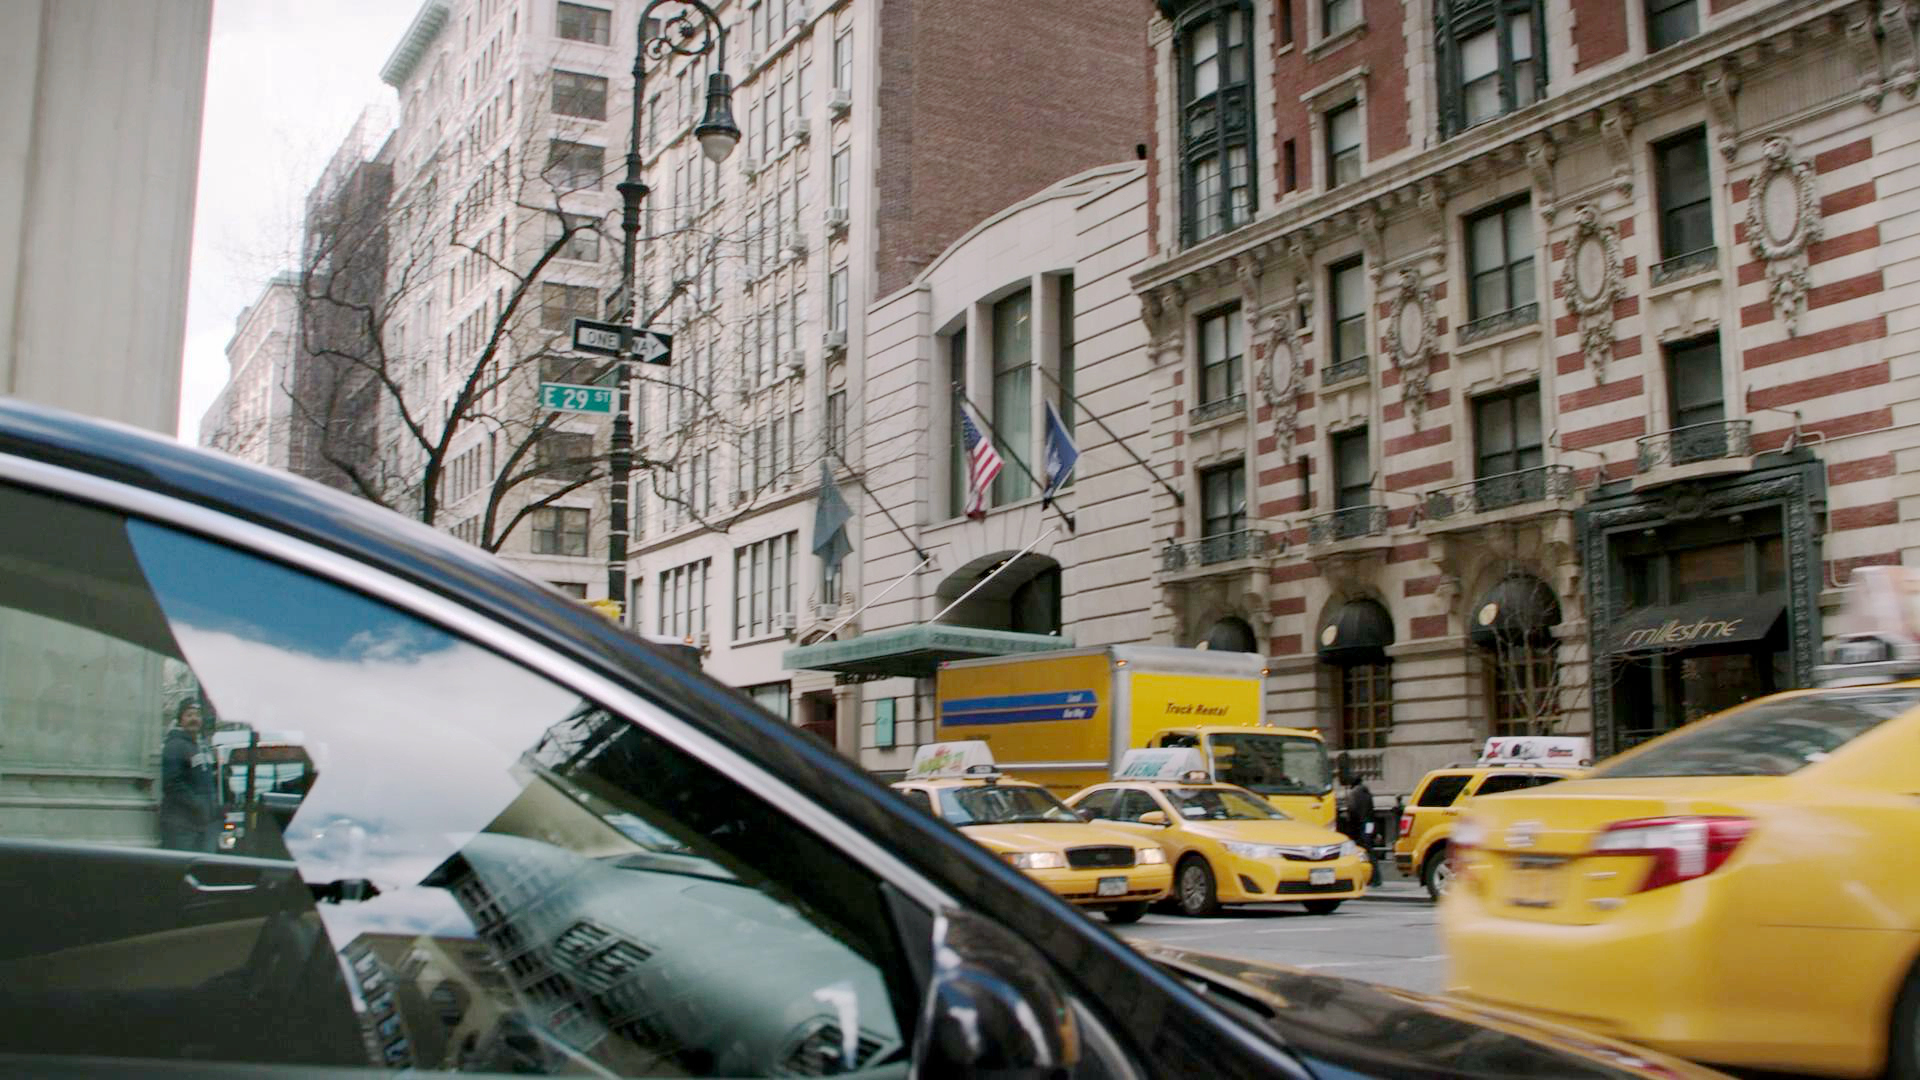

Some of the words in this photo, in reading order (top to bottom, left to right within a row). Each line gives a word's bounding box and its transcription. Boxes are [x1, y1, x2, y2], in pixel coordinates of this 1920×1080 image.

[587, 331, 618, 350] ONE
[543, 387, 557, 407] E
[562, 388, 590, 409] 29
[594, 391, 610, 403] ST
[1165, 702, 1193, 715] Truck
[1194, 704, 1231, 717] Rental
